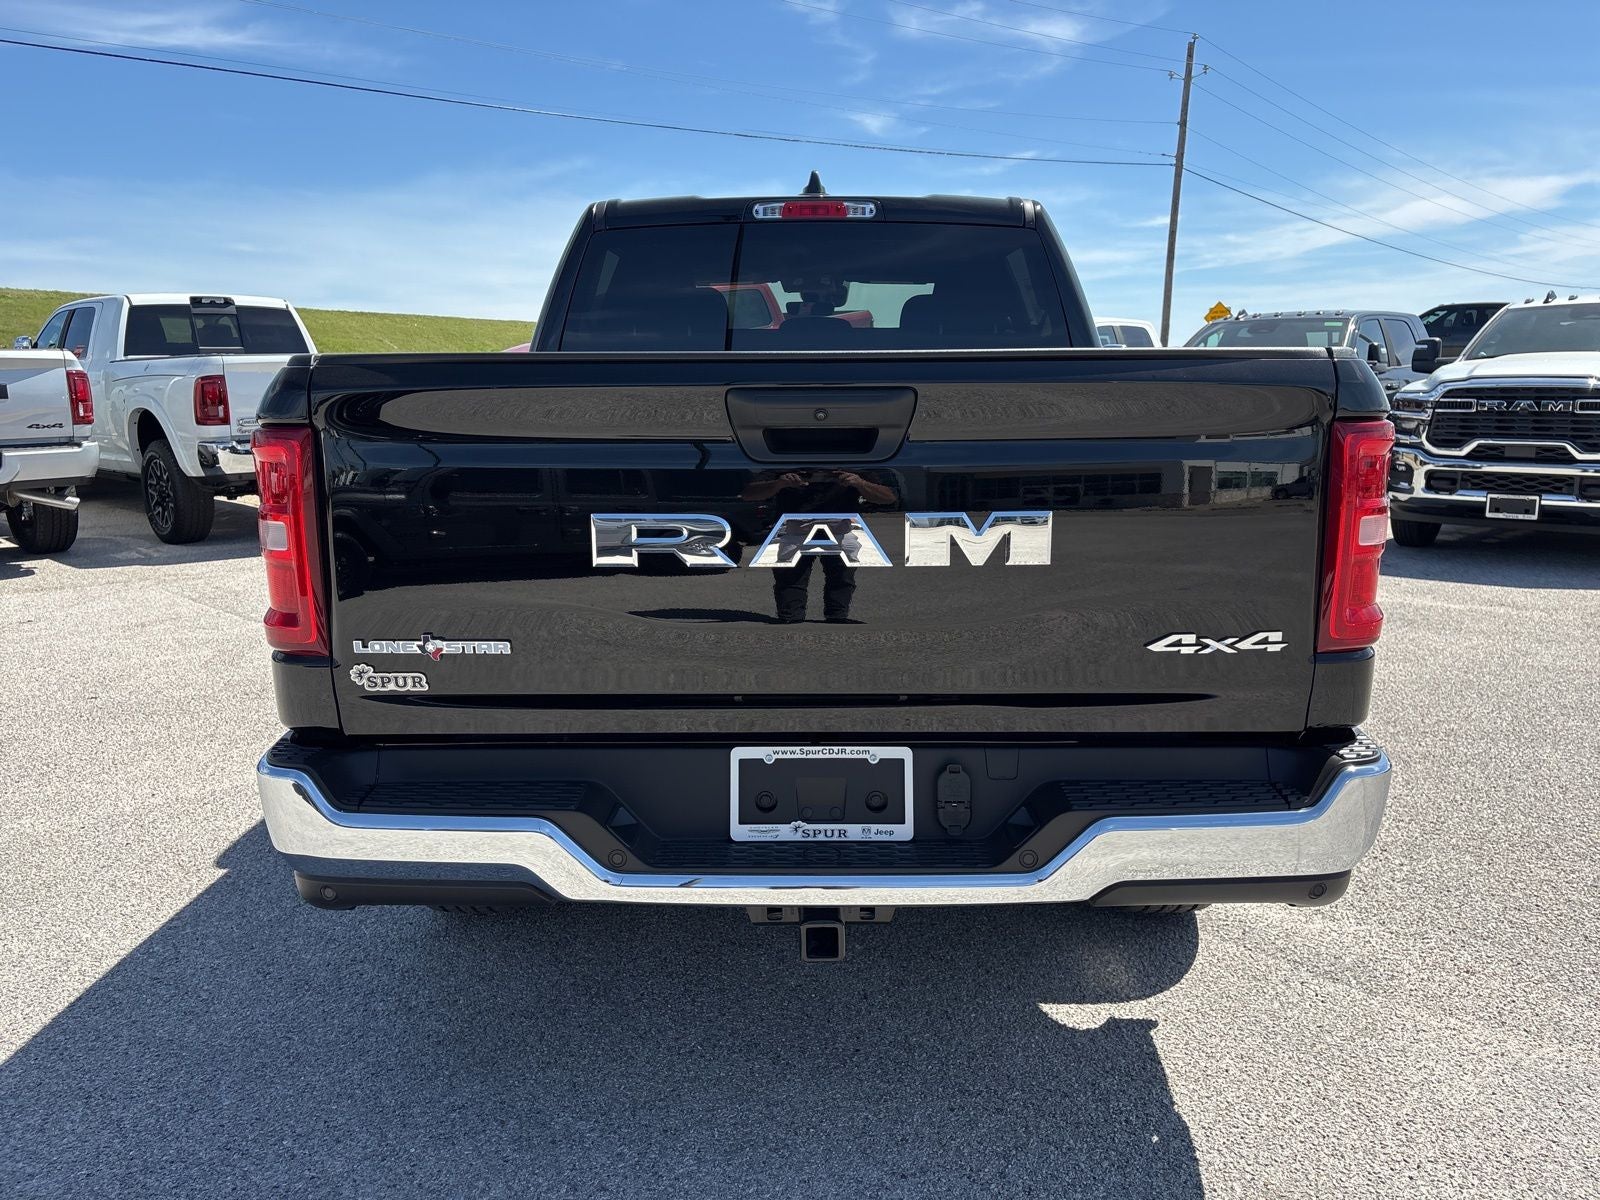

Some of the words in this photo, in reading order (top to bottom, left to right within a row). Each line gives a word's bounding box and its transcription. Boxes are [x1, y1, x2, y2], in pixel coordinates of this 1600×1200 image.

[1478, 400, 1573, 412] RAM
[591, 511, 1053, 568] RAM
[352, 640, 417, 654] LONE
[443, 641, 512, 655] STAR
[1146, 631, 1289, 654] 4x4
[366, 675, 426, 688] SPUR
[772, 748, 870, 756] www.SpurCDJR.com
[802, 828, 848, 838] SPUR
[873, 827, 895, 836] Jeep
